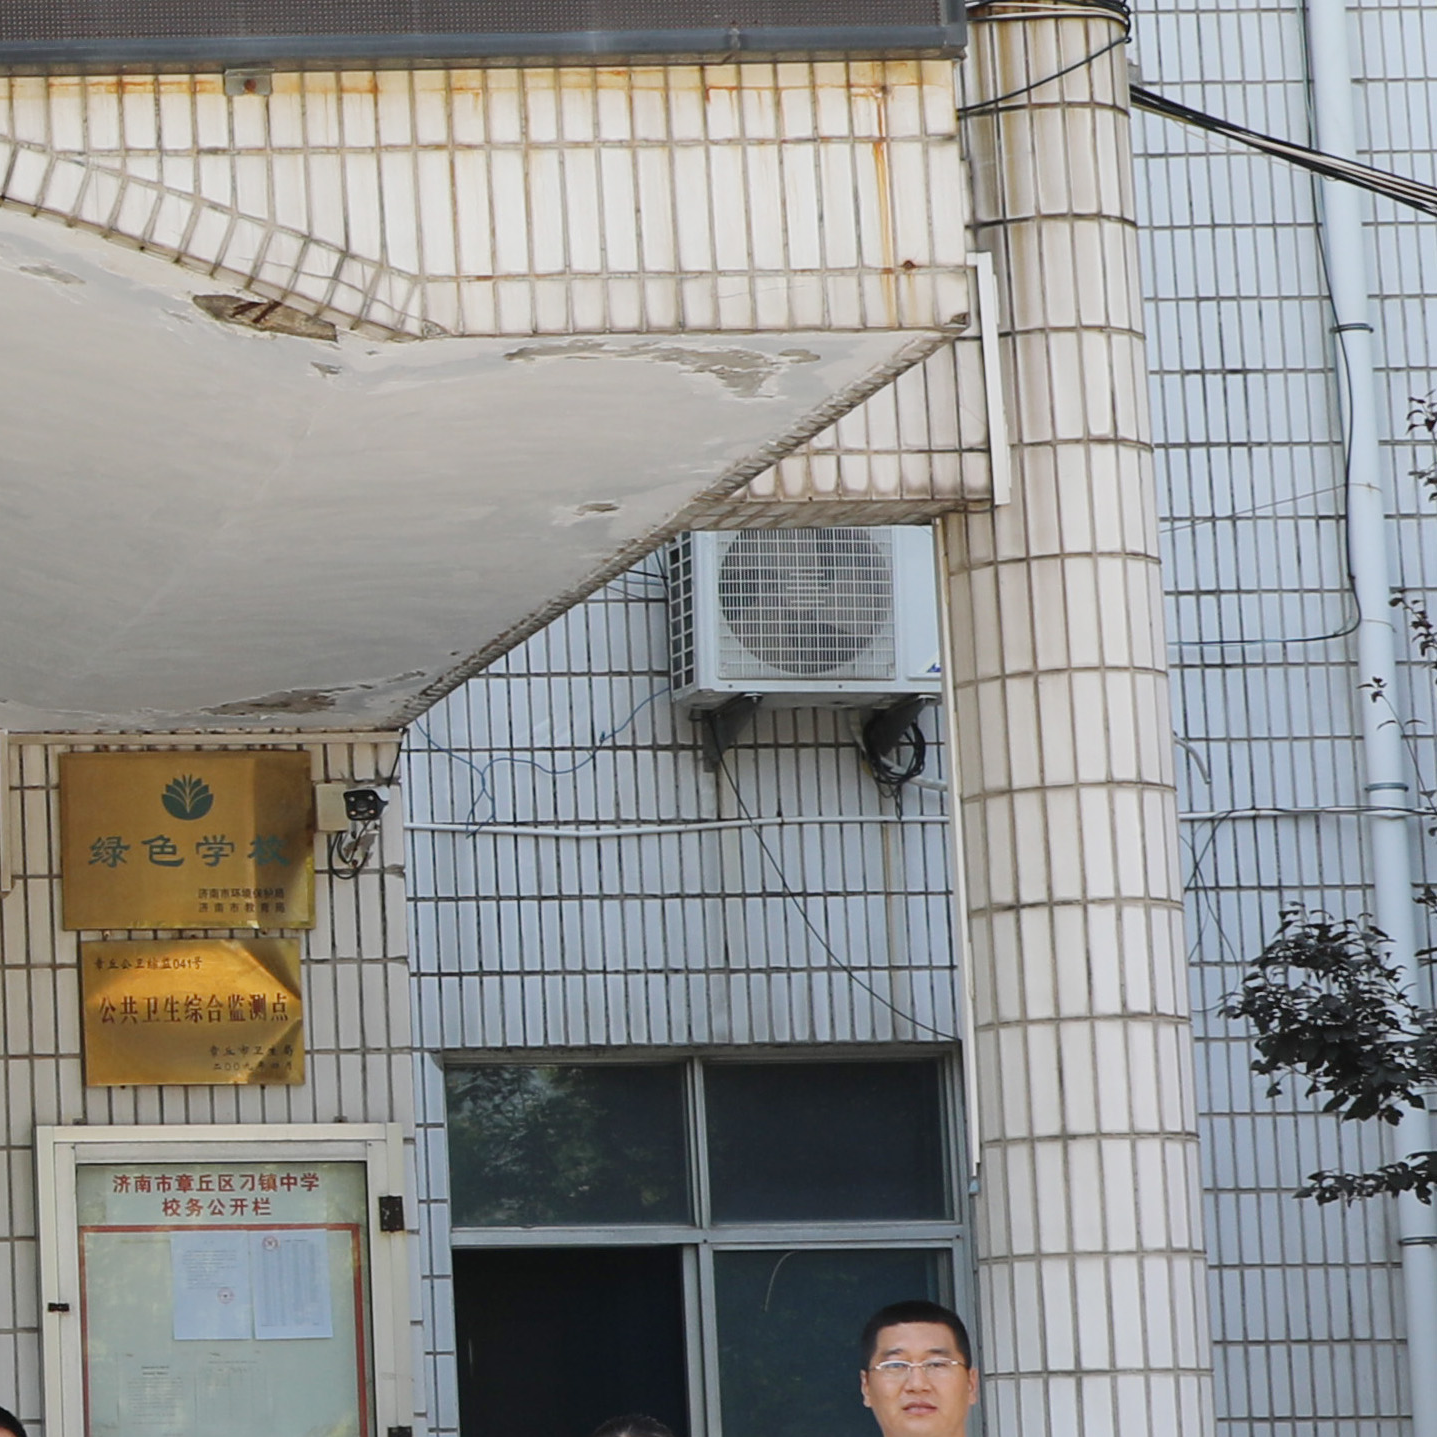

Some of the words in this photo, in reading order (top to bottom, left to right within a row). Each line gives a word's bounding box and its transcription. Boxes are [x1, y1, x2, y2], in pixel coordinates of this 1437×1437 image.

[87, 834, 290, 868] 绿色学校
[198, 901, 286, 913] 济南市教育局
[98, 991, 290, 1024] 公共卫生综合监测点
[112, 1173, 320, 1194] 济南市章丘区刁镇中学
[162, 1197, 272, 1217] 校务公开栏
